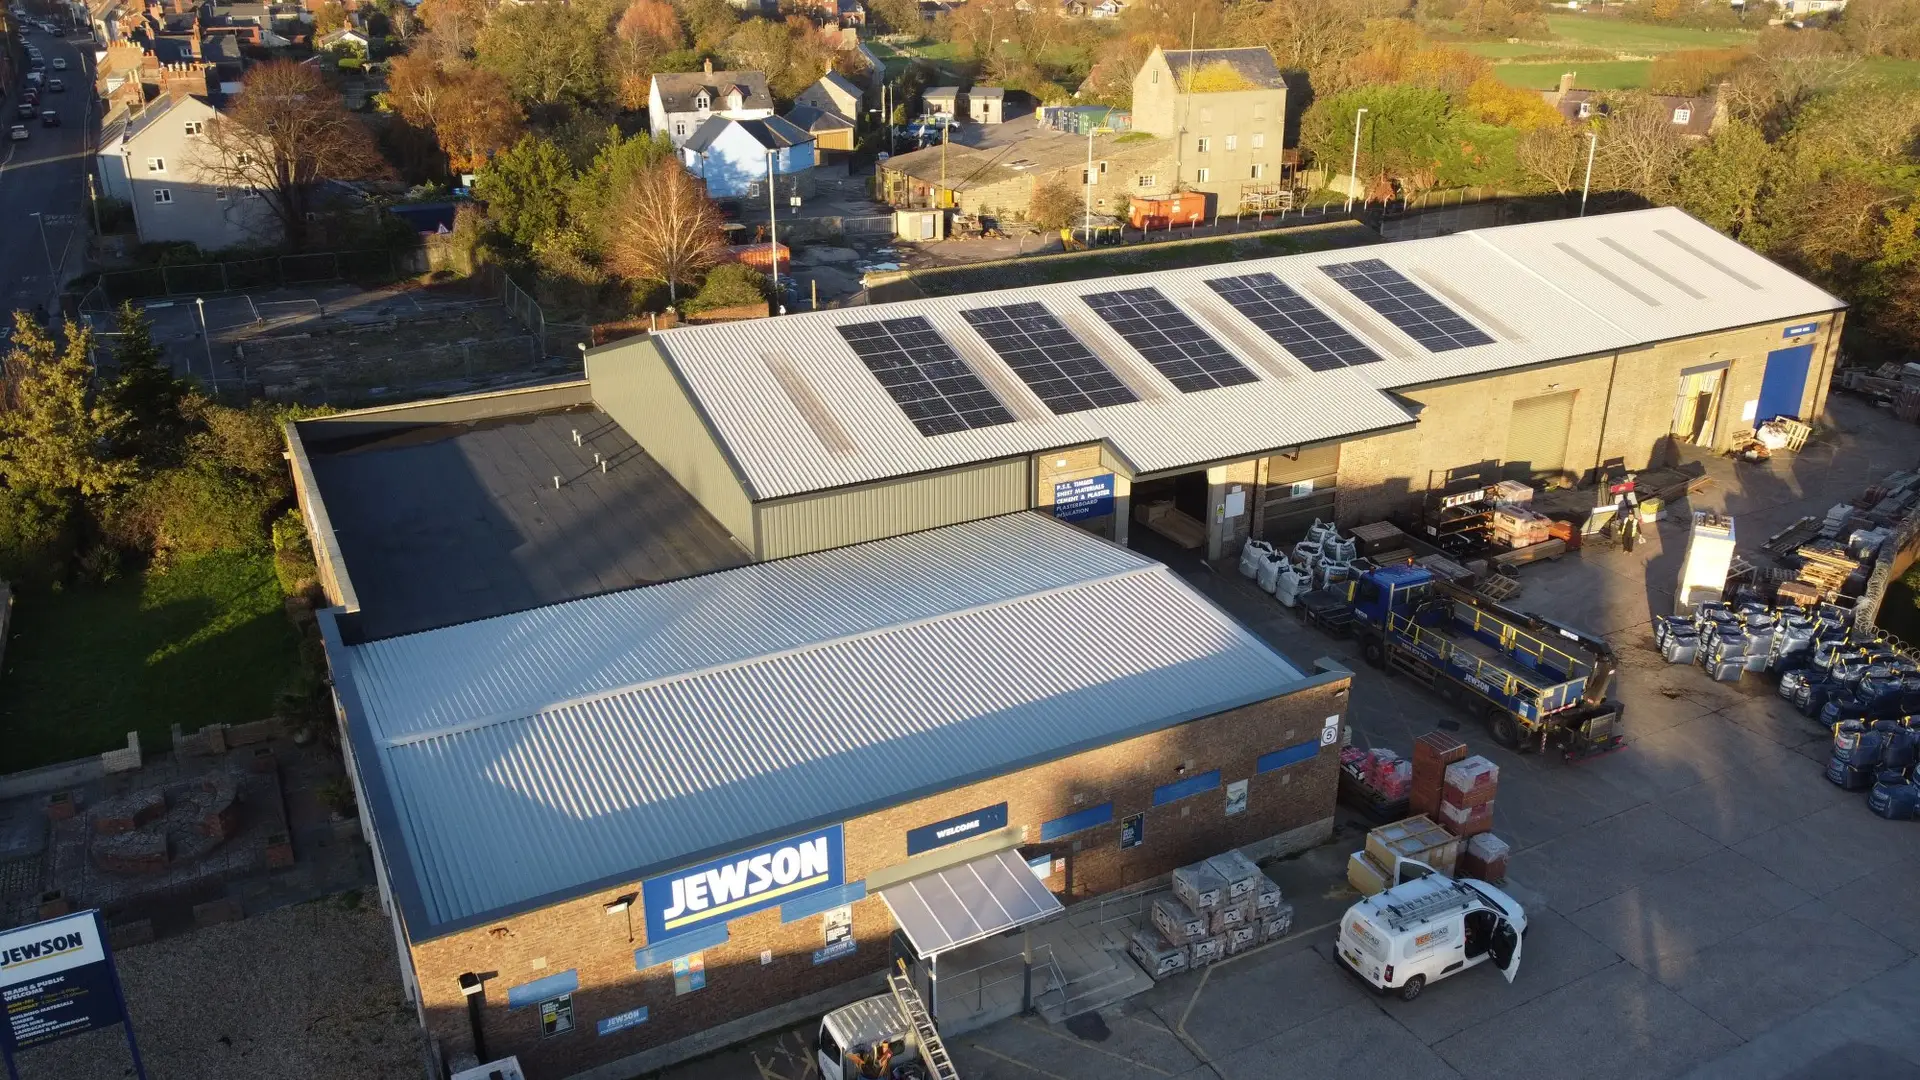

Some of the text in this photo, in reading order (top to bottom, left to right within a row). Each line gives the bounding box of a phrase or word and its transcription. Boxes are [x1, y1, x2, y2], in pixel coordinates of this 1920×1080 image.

[1056, 483, 1105, 498] SHEET MATERIALS
[1073, 478, 1094, 488] TIMBER
[1056, 495, 1079, 505] CEMENT
[1087, 489, 1110, 499] PLASTER
[1056, 499, 1099, 512] PLASTERBOARD
[1056, 507, 1090, 518] INSULATION
[1463, 672, 1490, 694] JEWSON
[1325, 729, 1333, 740] 5
[936, 819, 980, 839] WELCOME
[663, 836, 829, 921] JEWSON
[1, 931, 83, 966] JEWSON
[3, 985, 28, 997] TRADE
[37, 976, 65, 988] PUBLIC
[4, 987, 44, 1002] WELCOME
[10, 1000, 74, 1021] BUILDING MATERIALS
[607, 1009, 640, 1027] JEWSON
[11, 1016, 34, 1026] TIMBER
[13, 1023, 29, 1031] TOOL
[14, 1020, 58, 1036] LANDSCAPING
[15, 1029, 45, 1040] KITCHENS
[51, 1016, 90, 1030] BATHROOMS
